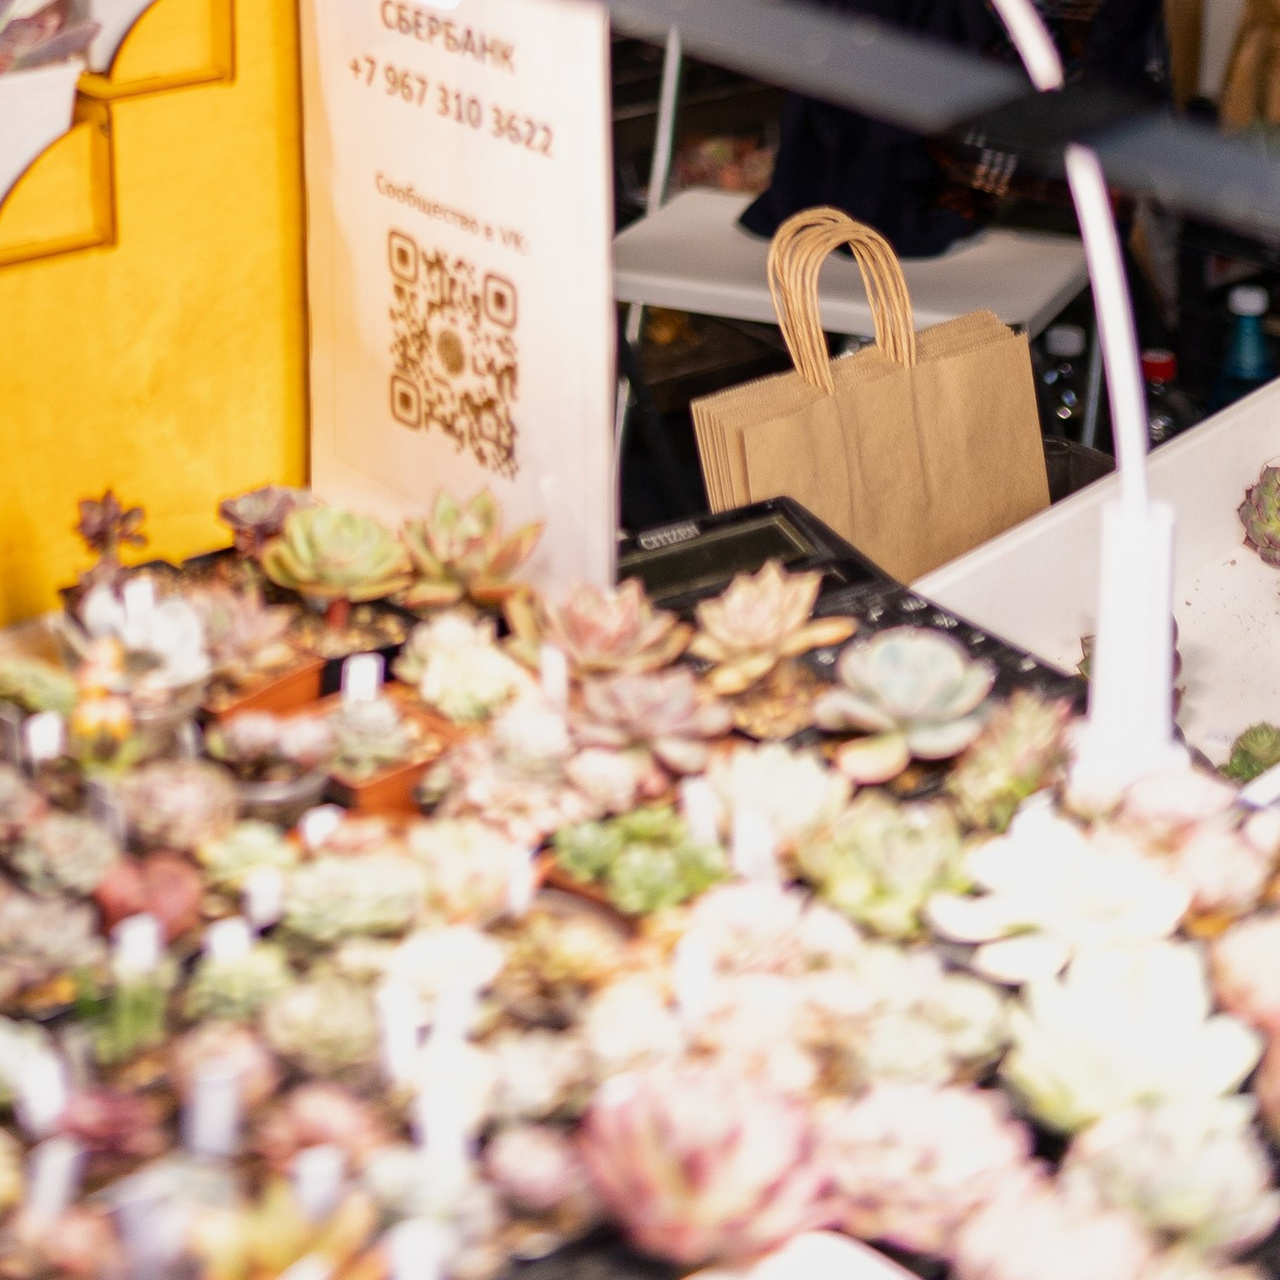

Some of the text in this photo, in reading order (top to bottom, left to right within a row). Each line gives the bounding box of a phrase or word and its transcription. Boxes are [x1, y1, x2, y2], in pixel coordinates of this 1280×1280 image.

[349, 53, 555, 159] +7 967 310 3622
[375, 170, 480, 237] Сообщество
